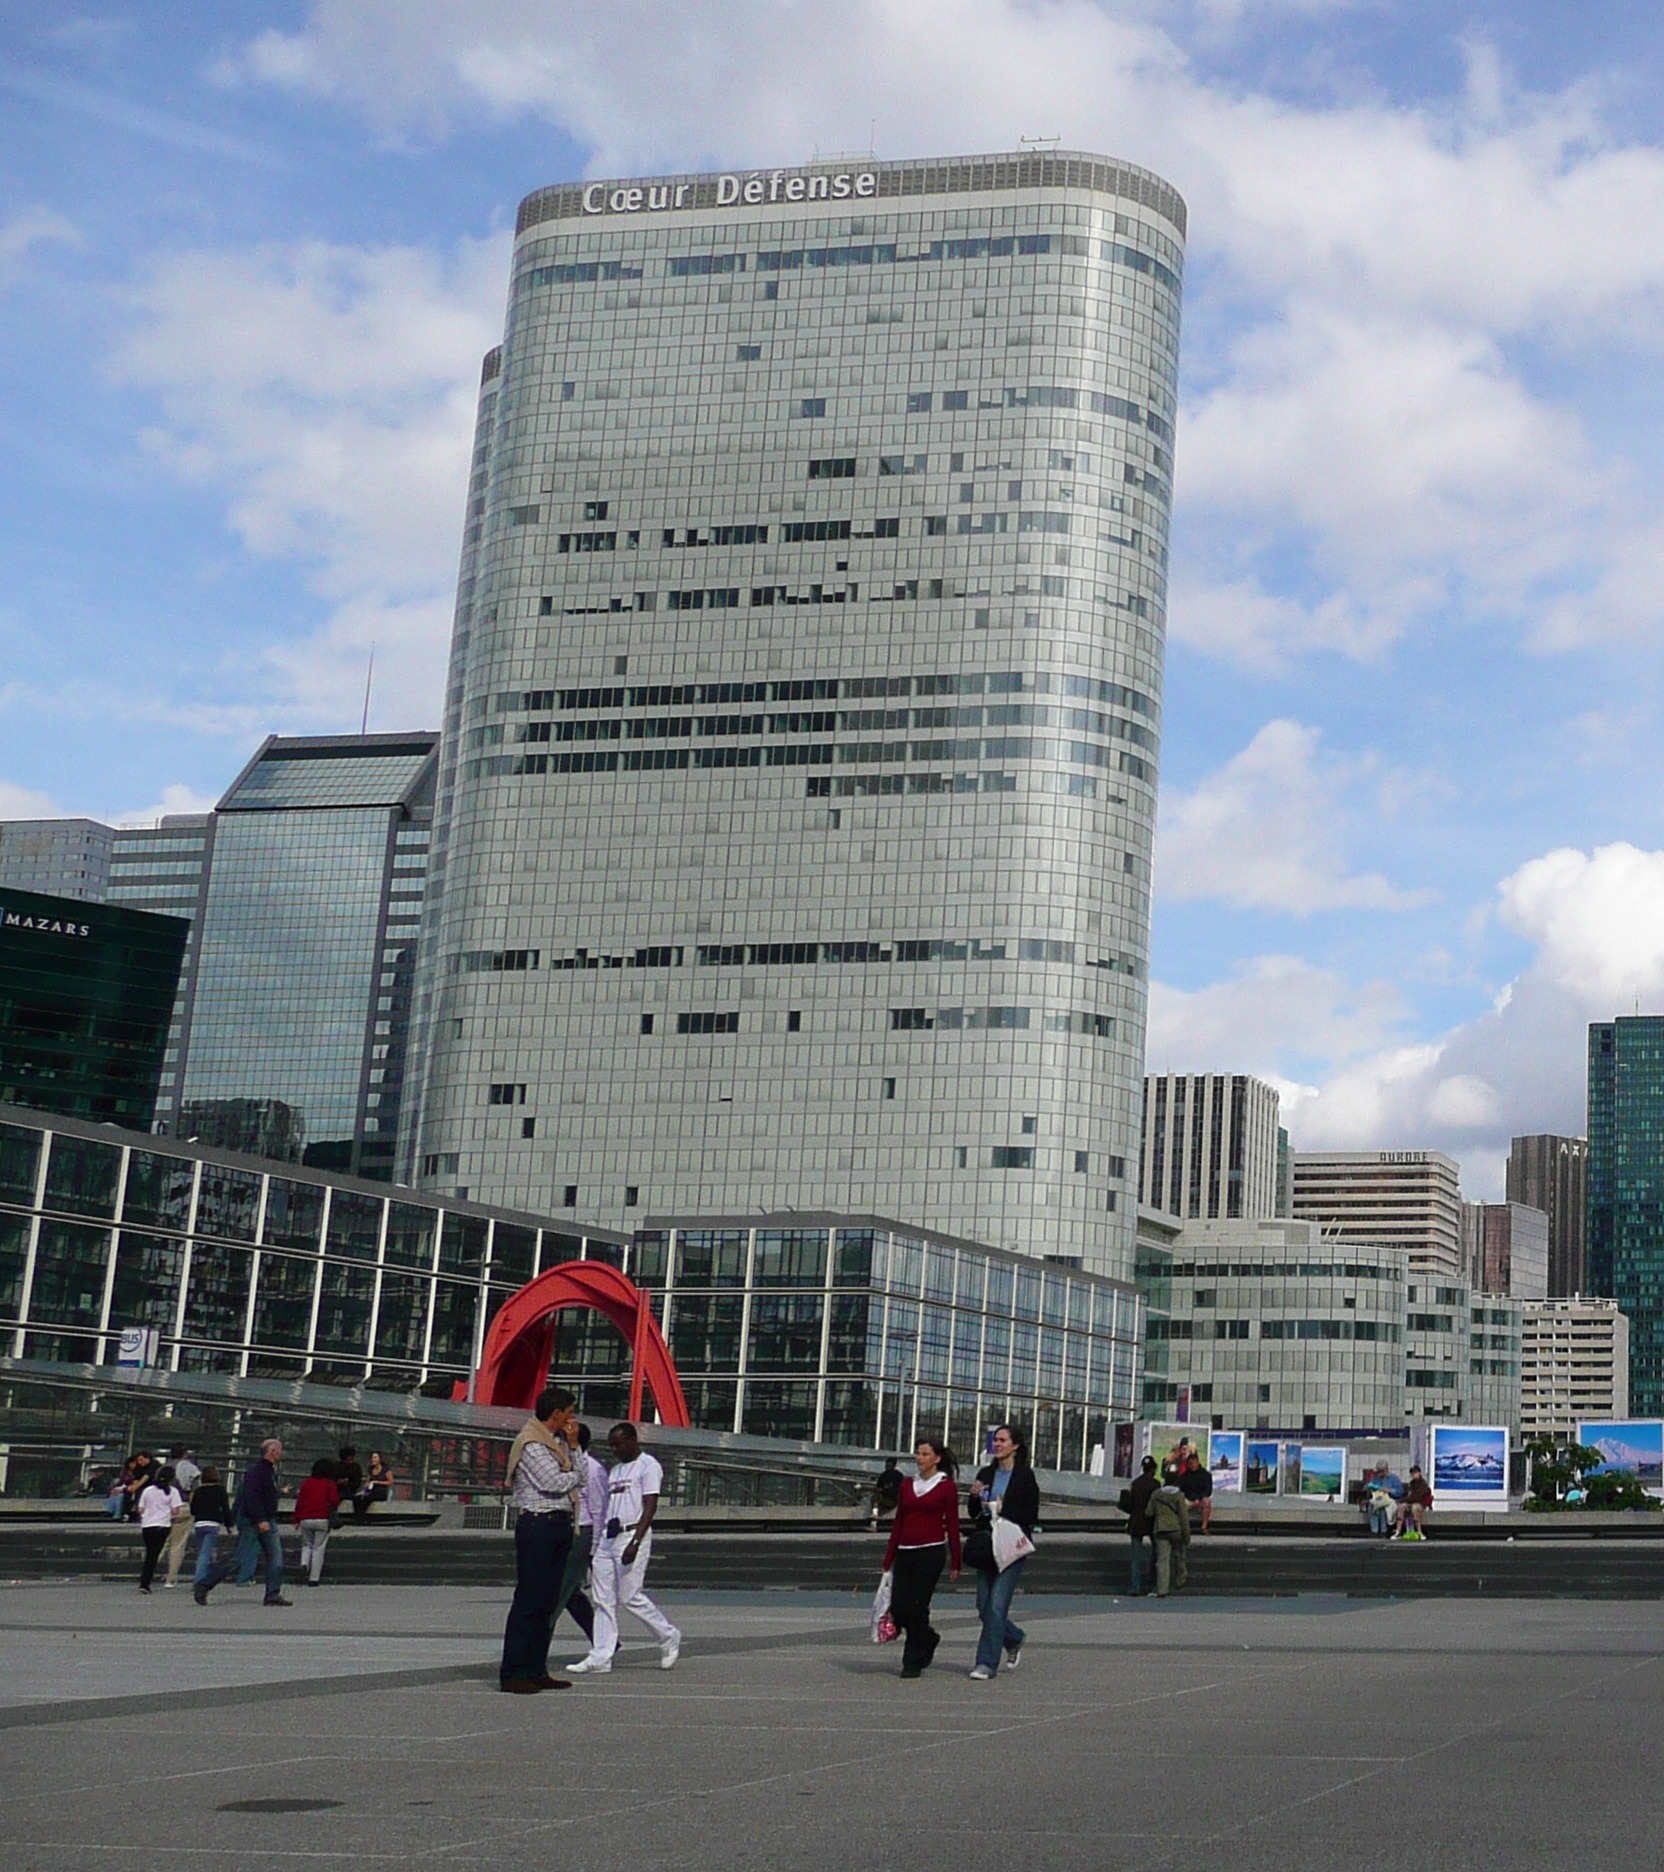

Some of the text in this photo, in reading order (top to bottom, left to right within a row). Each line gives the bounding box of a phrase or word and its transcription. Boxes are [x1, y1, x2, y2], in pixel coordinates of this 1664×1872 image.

[582, 169, 876, 213] Cœur Défense
[5, 913, 90, 937] MAZARS
[1380, 1151, 1428, 1162] AURORE
[120, 1333, 139, 1344] BUS
